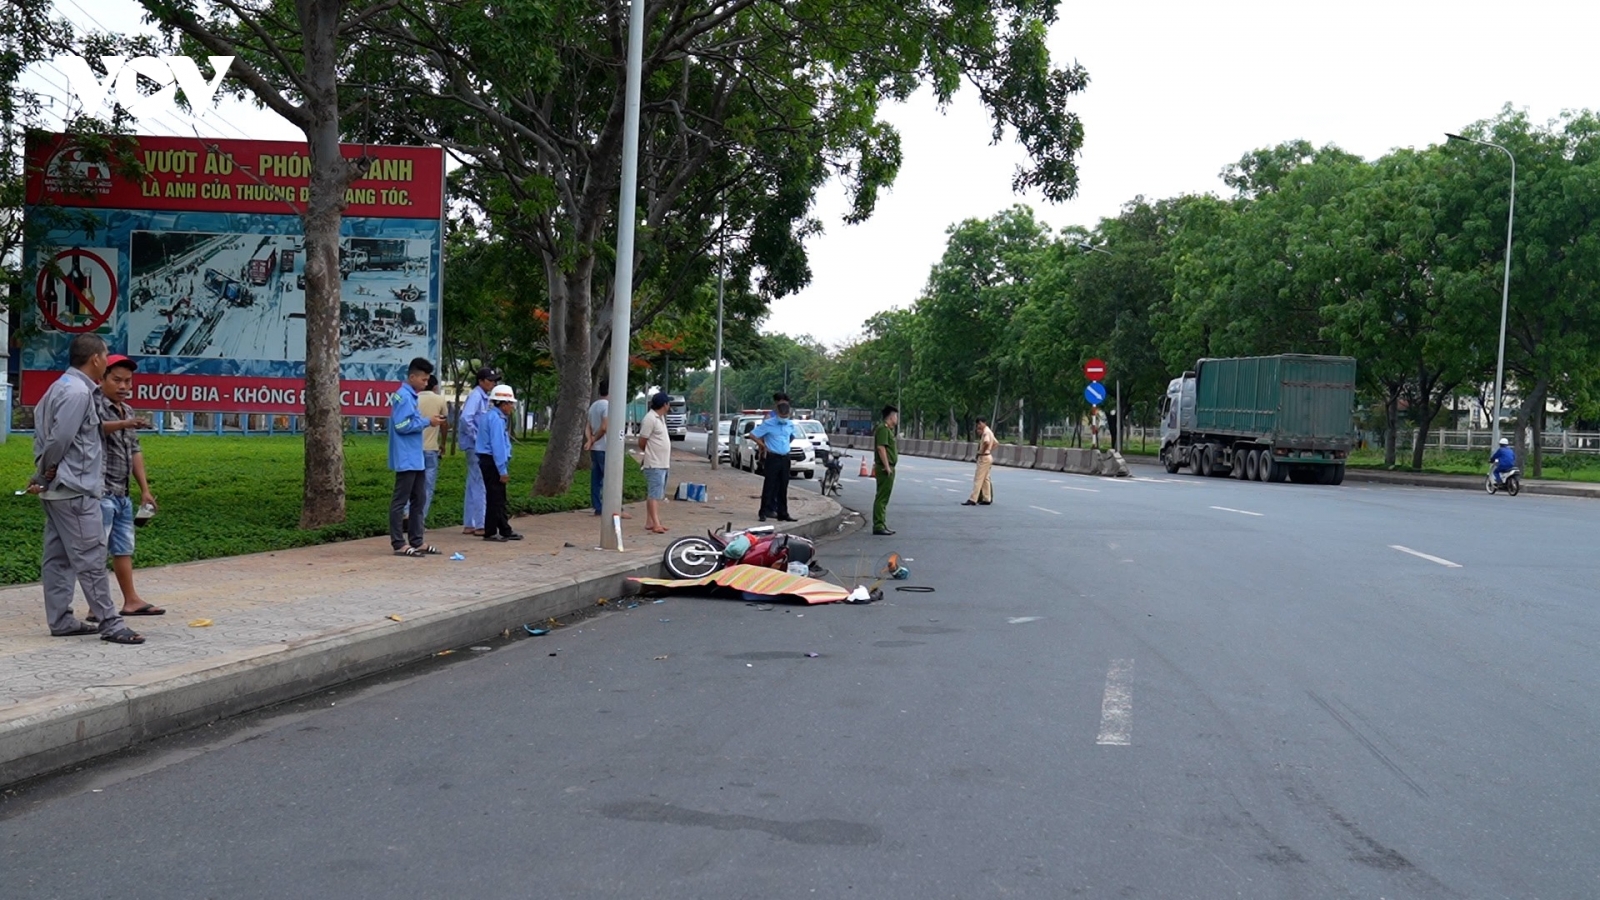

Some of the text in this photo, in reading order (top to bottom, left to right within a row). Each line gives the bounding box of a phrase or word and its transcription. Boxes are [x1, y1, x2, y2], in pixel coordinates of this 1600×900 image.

[144, 149, 198, 178] VƯỢT
[165, 182, 196, 199] ANH
[201, 178, 231, 199] CỦA
[380, 187, 413, 206] TÓC.
[138, 383, 187, 405] RƯỢU
[192, 386, 219, 402] BIA
[233, 386, 296, 405] KHÔNG
[354, 388, 380, 407] LÁI
